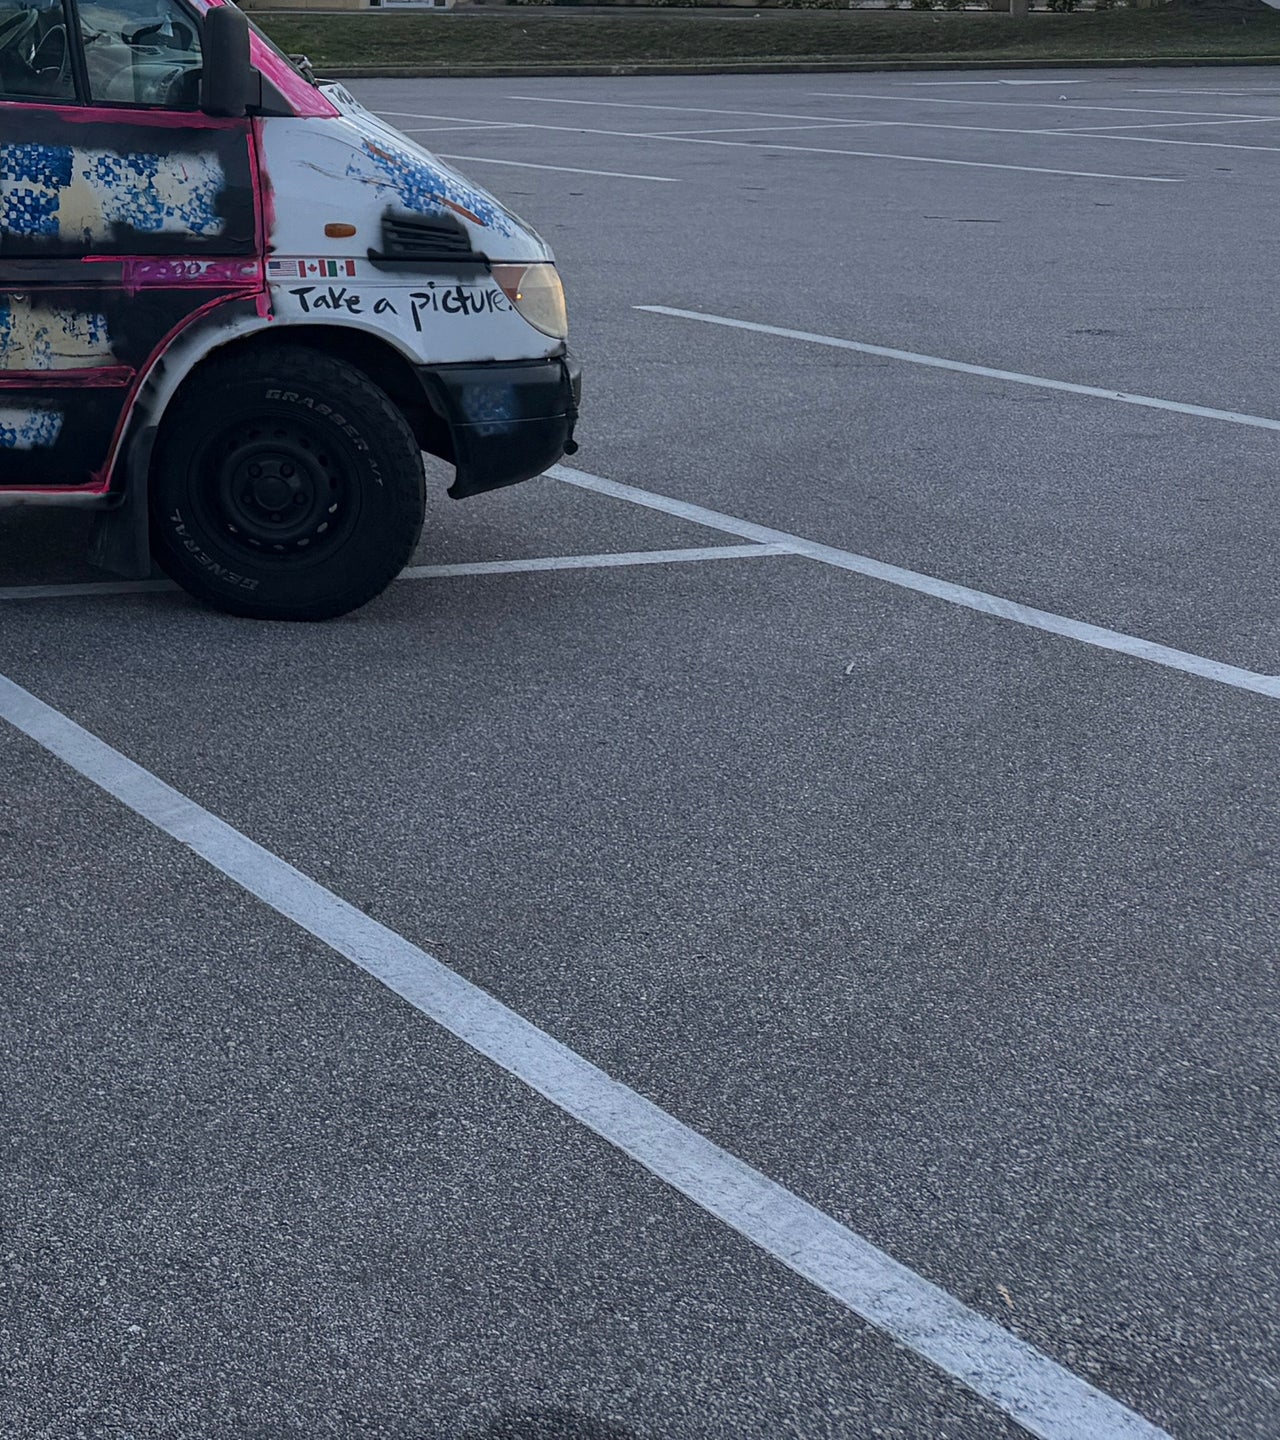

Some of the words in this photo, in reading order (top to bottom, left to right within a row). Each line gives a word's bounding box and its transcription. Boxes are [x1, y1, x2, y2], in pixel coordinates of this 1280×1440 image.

[289, 285, 363, 314] Take
[373, 297, 399, 315] a
[409, 280, 515, 332] picture.
[265, 388, 370, 452] GRABBER
[170, 508, 260, 591] GENERAL
